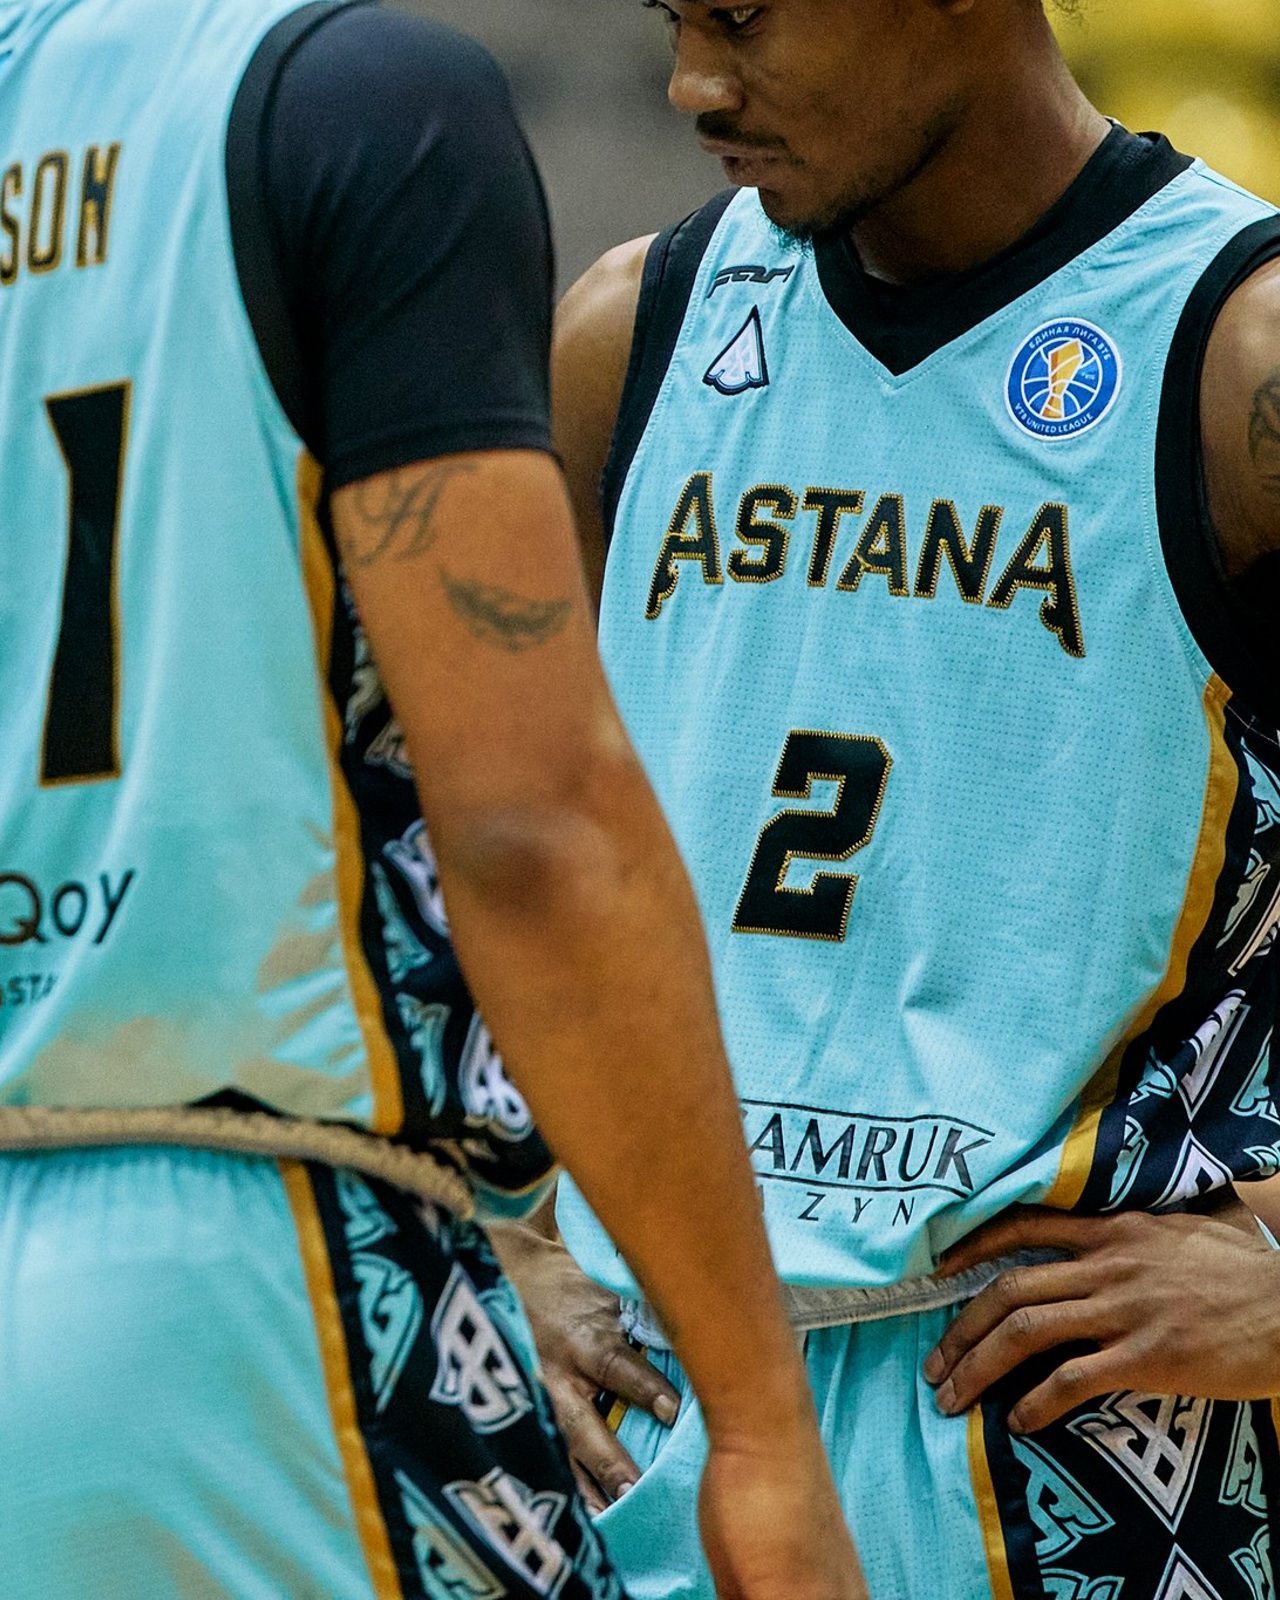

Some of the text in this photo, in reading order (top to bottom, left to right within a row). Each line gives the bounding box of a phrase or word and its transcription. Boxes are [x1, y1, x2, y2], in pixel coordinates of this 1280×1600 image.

[1029, 326, 1112, 361] ЕДИНАЯ ЛИГА ВТБ
[1015, 403, 1094, 433] VTB UNITED LEAGUE
[644, 471, 1086, 658] ASTANA
[731, 729, 893, 943] 2
[742, 1109, 991, 1191] AMRUK
[758, 1185, 915, 1227] ZYN
